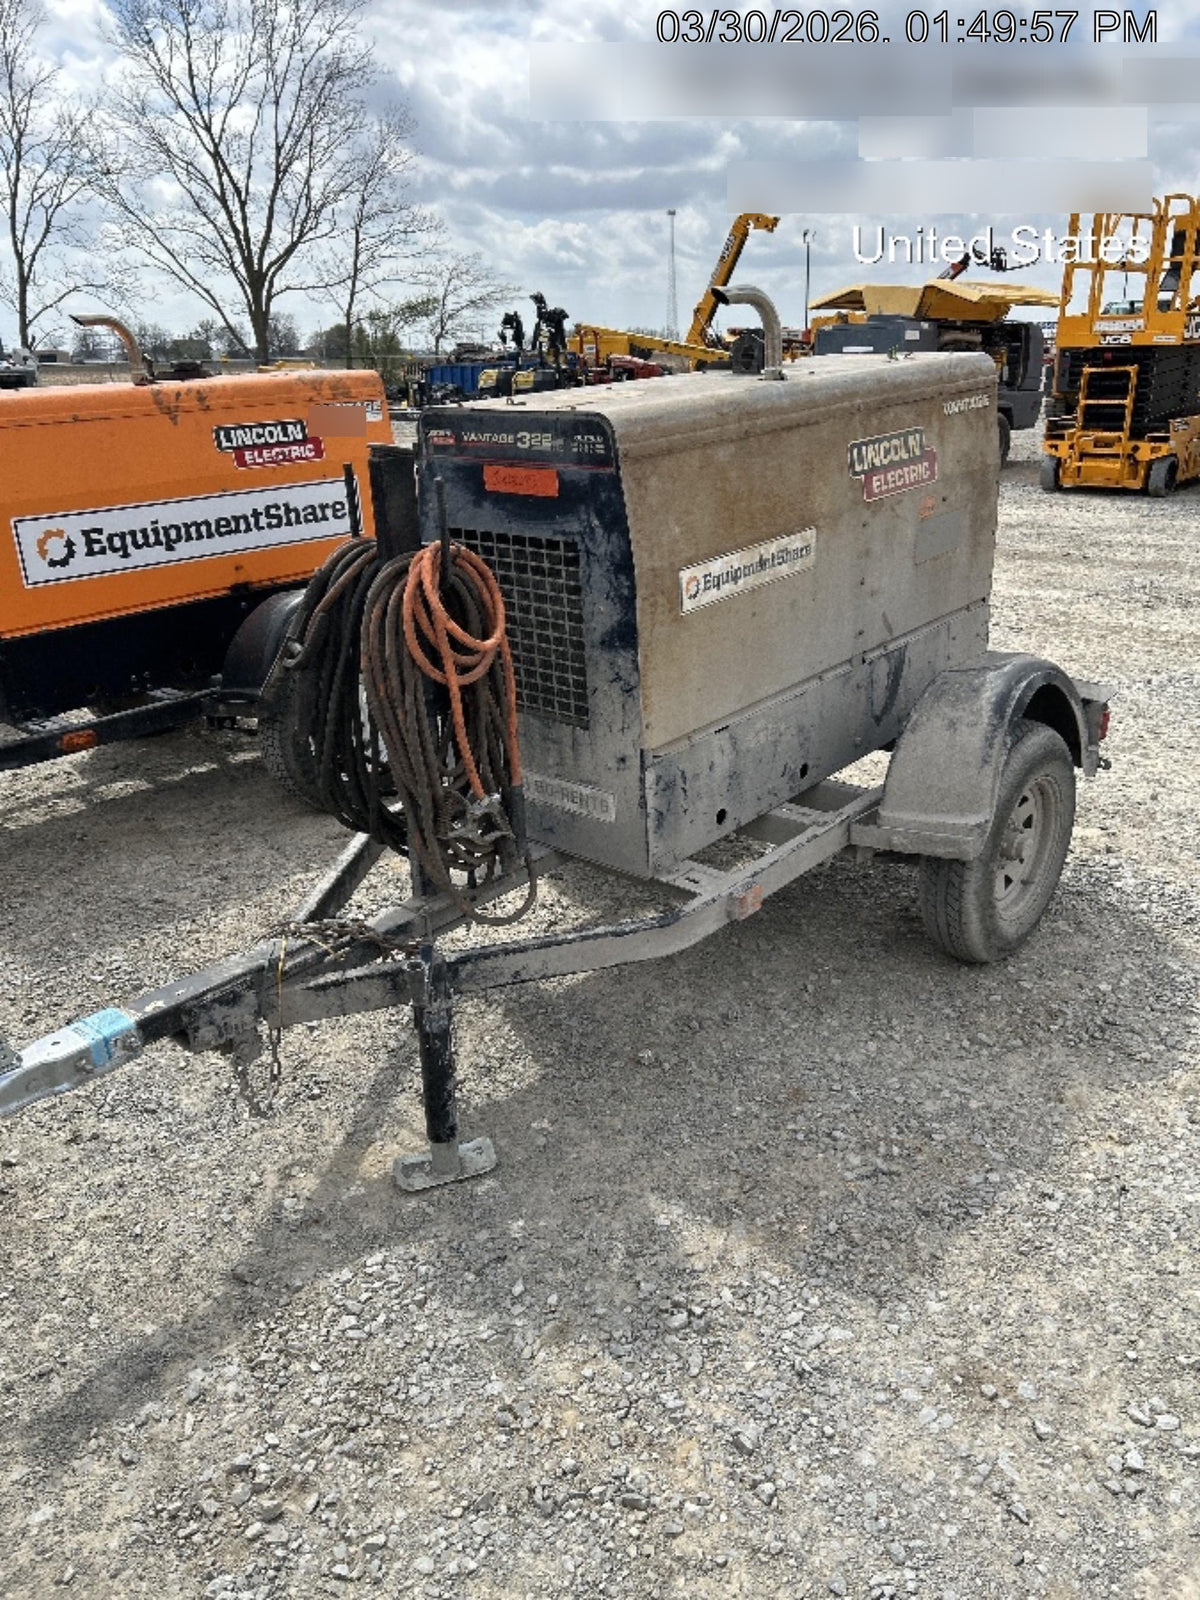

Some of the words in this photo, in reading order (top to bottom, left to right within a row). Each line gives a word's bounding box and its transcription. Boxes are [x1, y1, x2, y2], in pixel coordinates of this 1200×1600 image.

[219, 422, 303, 447] LINCOLN
[461, 431, 515, 444] VANTAGE
[244, 444, 315, 464] ELECTRIC
[853, 434, 920, 471] LINCOLN
[872, 461, 931, 494] ELECTRIC
[81, 500, 348, 558] EquipmentShare
[701, 543, 812, 593] EquipmentShare
